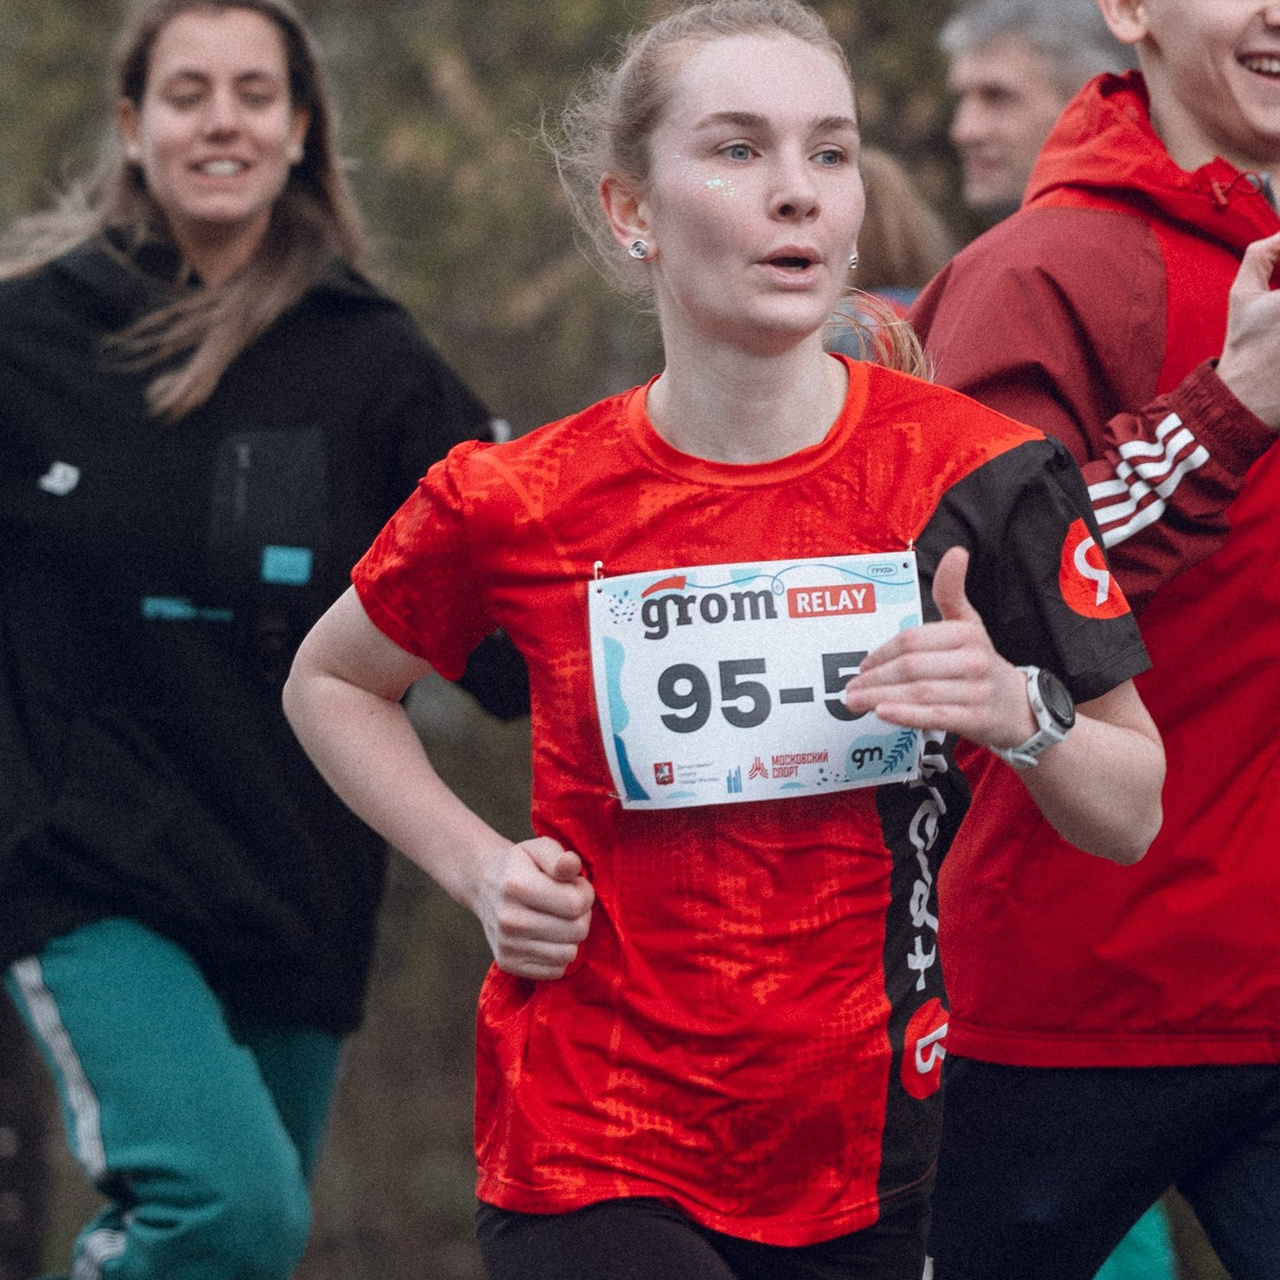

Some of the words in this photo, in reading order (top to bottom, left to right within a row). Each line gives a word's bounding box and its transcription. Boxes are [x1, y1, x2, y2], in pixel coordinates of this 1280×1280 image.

[641, 587, 778, 640] grom
[796, 588, 867, 614] RELAY
[657, 650, 870, 734] 95-5
[771, 749, 829, 766] МОСКОВСКИЙ
[772, 767, 799, 779] СПОРТ
